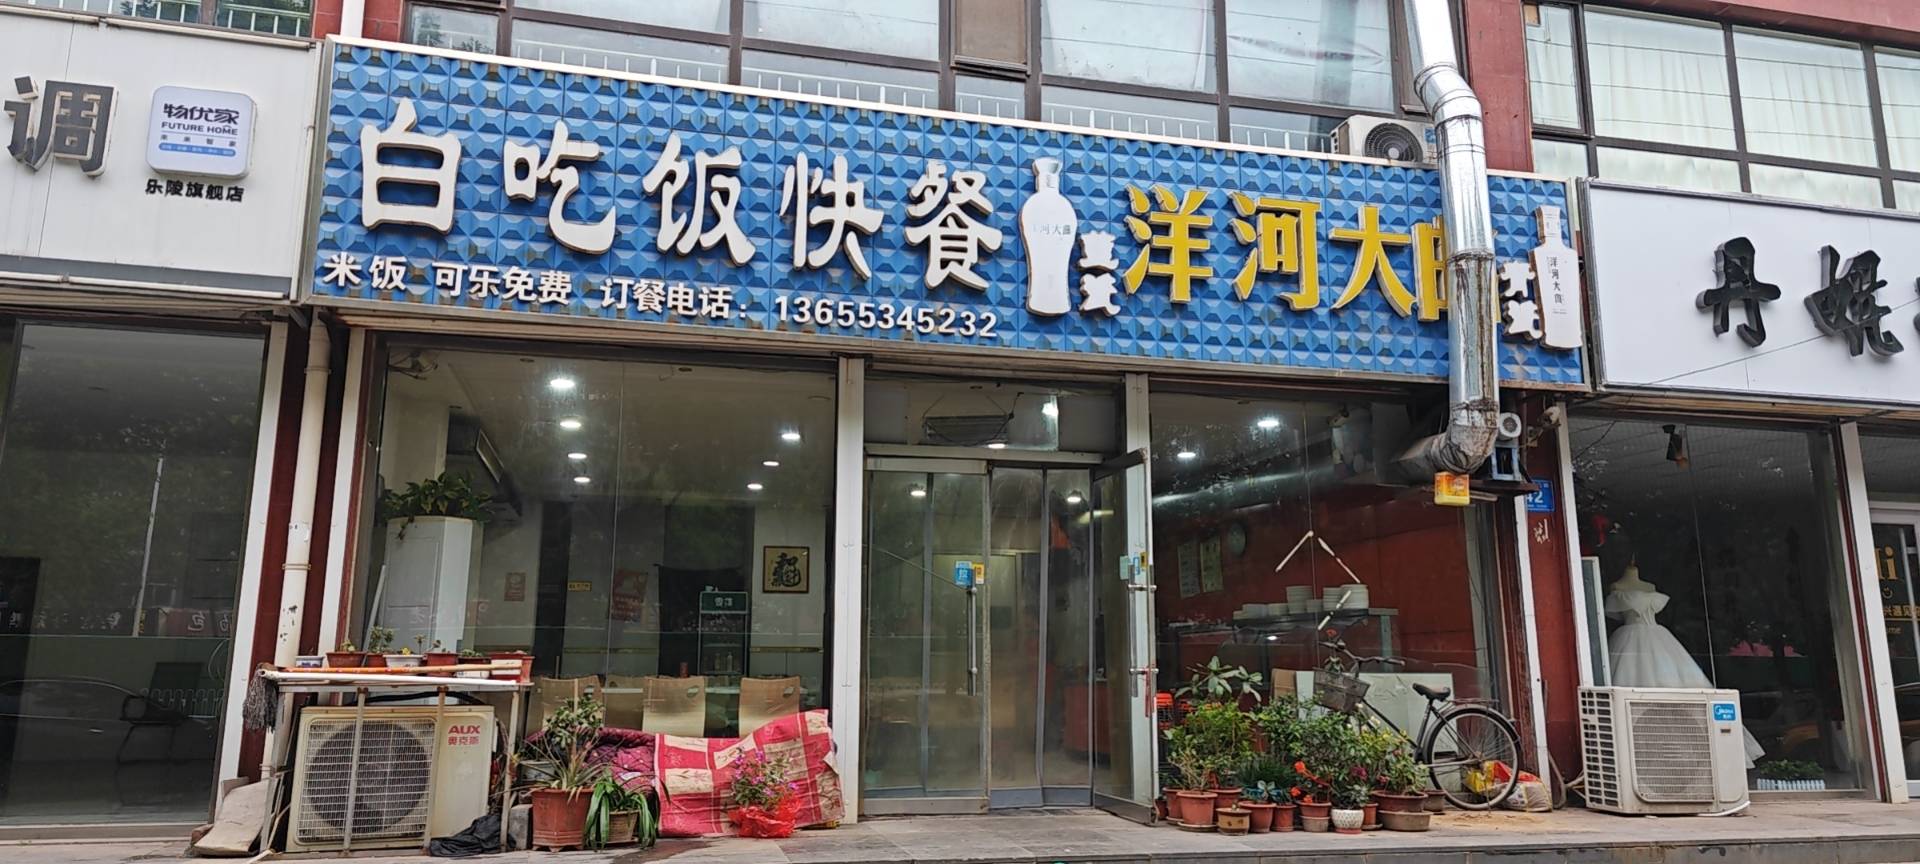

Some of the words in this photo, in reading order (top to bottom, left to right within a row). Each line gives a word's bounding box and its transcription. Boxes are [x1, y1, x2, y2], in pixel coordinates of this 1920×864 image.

[4, 75, 117, 177] 调
[163, 103, 240, 125] 物优家
[161, 121, 204, 132] FUTURE
[207, 125, 238, 136] HOME
[145, 178, 245, 202] 乐陵旗舰店
[360, 97, 1002, 290] 白吃饭快餐
[323, 252, 408, 291] 米饭
[432, 261, 572, 306] 可乐免费
[775, 295, 999, 339] 13655345232
[448, 725, 480, 734] AUX
